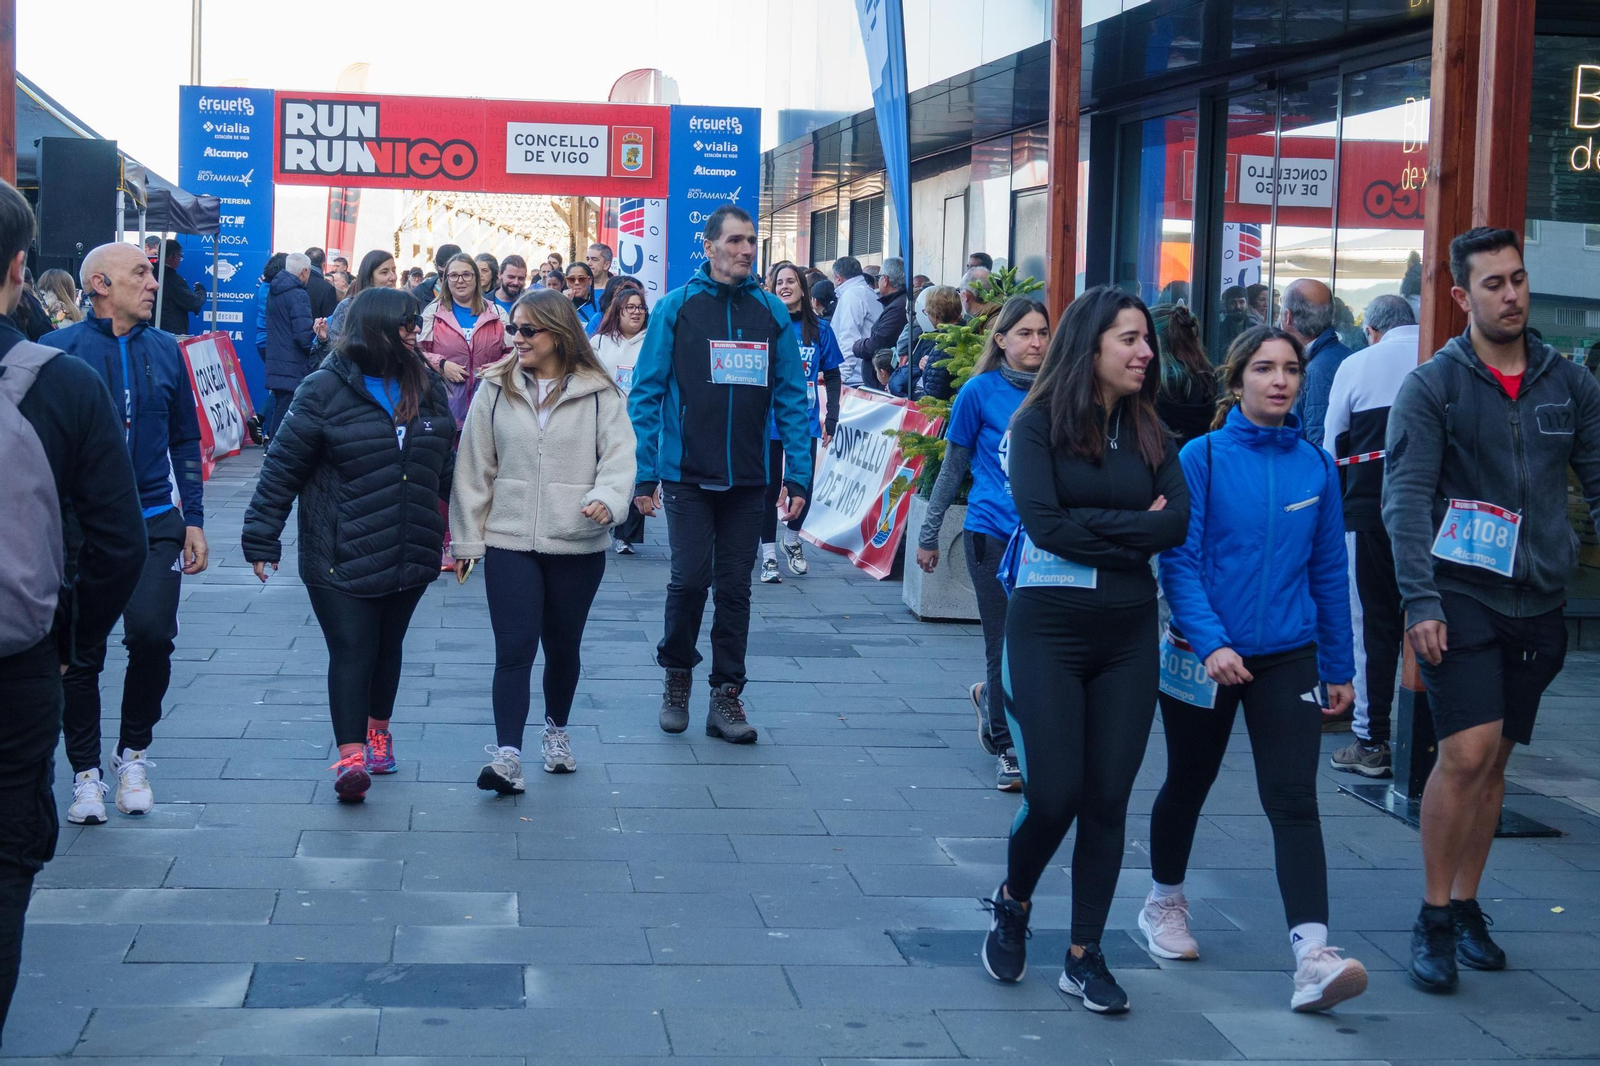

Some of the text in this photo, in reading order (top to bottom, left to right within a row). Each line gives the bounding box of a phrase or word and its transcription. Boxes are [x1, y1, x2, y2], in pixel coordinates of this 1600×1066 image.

[286, 103, 376, 138] RUN
[215, 122, 250, 134] vialia
[514, 134, 598, 148] CONCELLO
[704, 142, 738, 152] vialia
[204, 146, 248, 160] Alcampo
[524, 150, 589, 164] DE VIGO
[197, 173, 239, 182] BOTAMAVI
[694, 165, 736, 178] Alcampo
[1402, 160, 1418, 190] de
[687, 192, 728, 200] BOTAMAVI
[724, 353, 762, 370] 6055
[725, 374, 757, 384] Alcampo
[816, 470, 867, 519] DE VIGO
[1462, 518, 1508, 548] 6108
[1450, 546, 1496, 566] Alcampo
[1027, 571, 1074, 583] Alcampo
[1160, 649, 1208, 684] 6050
